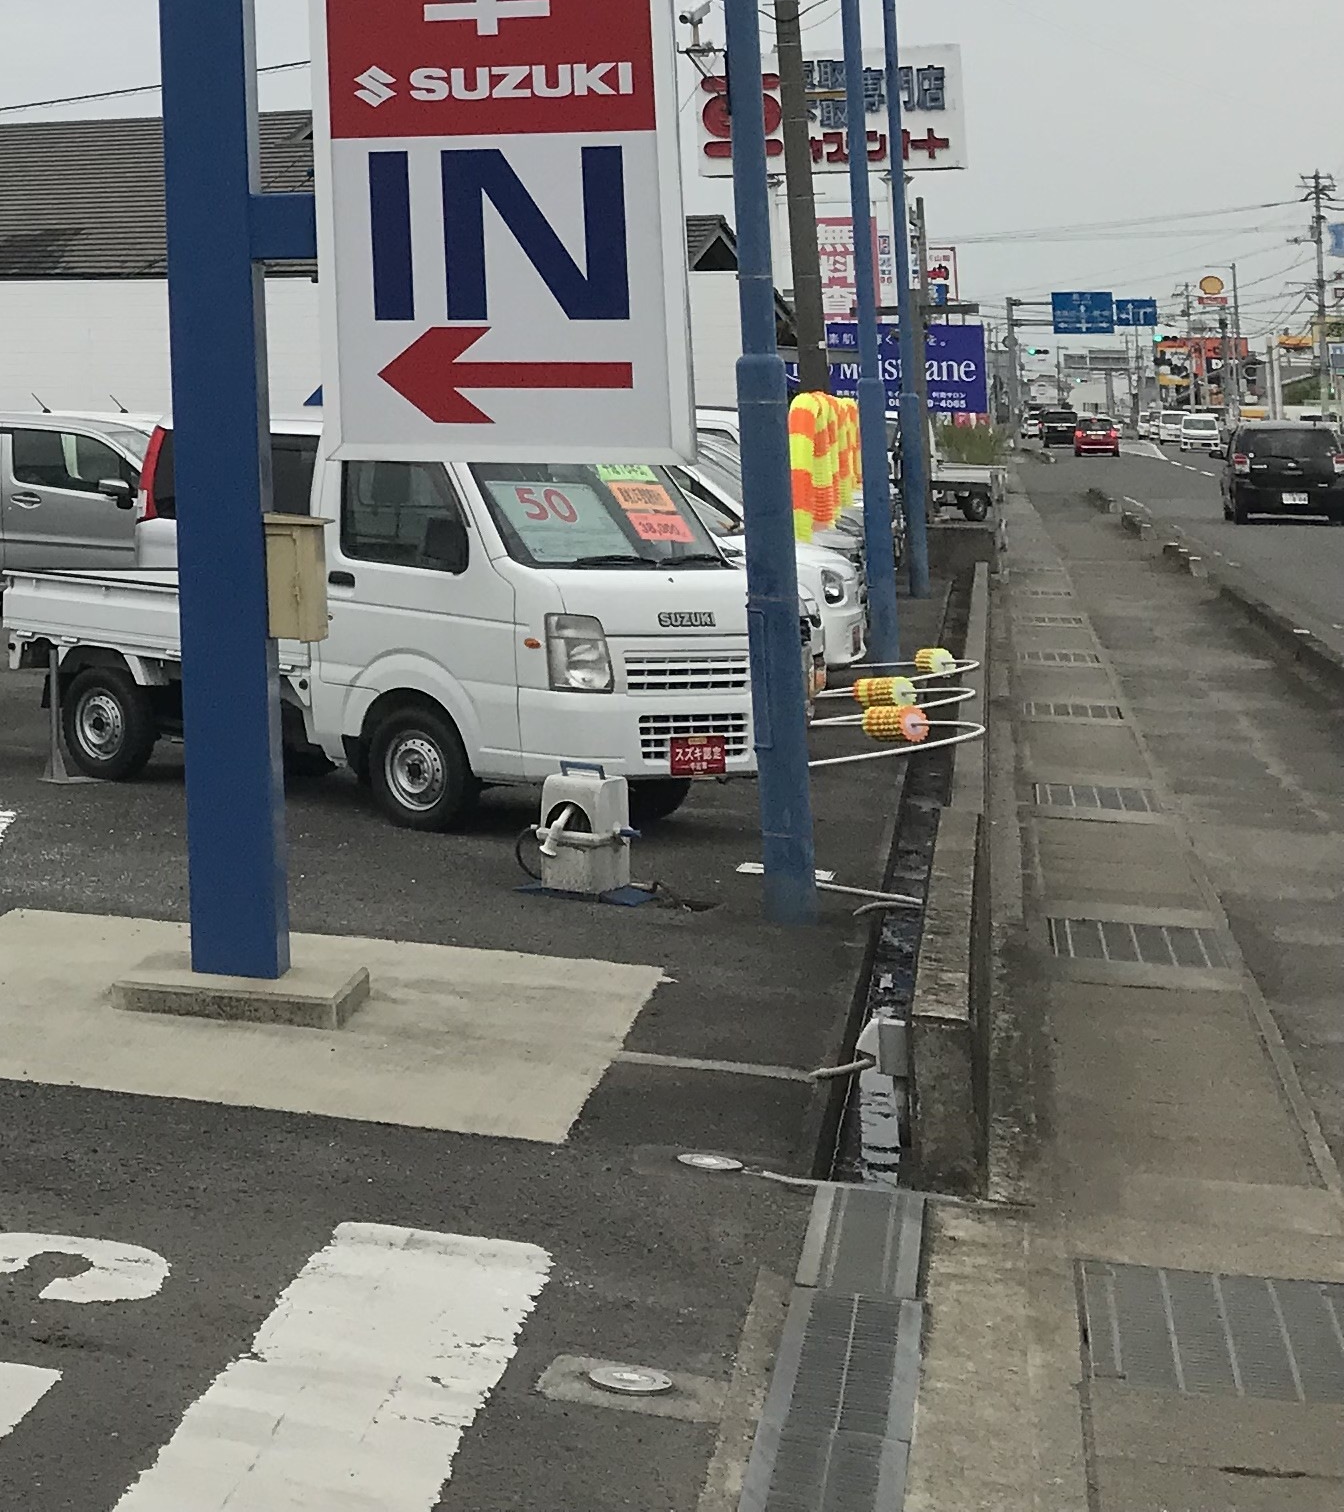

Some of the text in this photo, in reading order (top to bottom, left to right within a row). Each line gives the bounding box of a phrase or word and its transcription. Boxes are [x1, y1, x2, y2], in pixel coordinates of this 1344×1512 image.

[409, 62, 633, 101] SUZUKI
[368, 145, 630, 322] IN
[515, 486, 579, 524] 50
[658, 611, 716, 627] SUZUKI
[675, 746, 722, 761] スズキ認定
